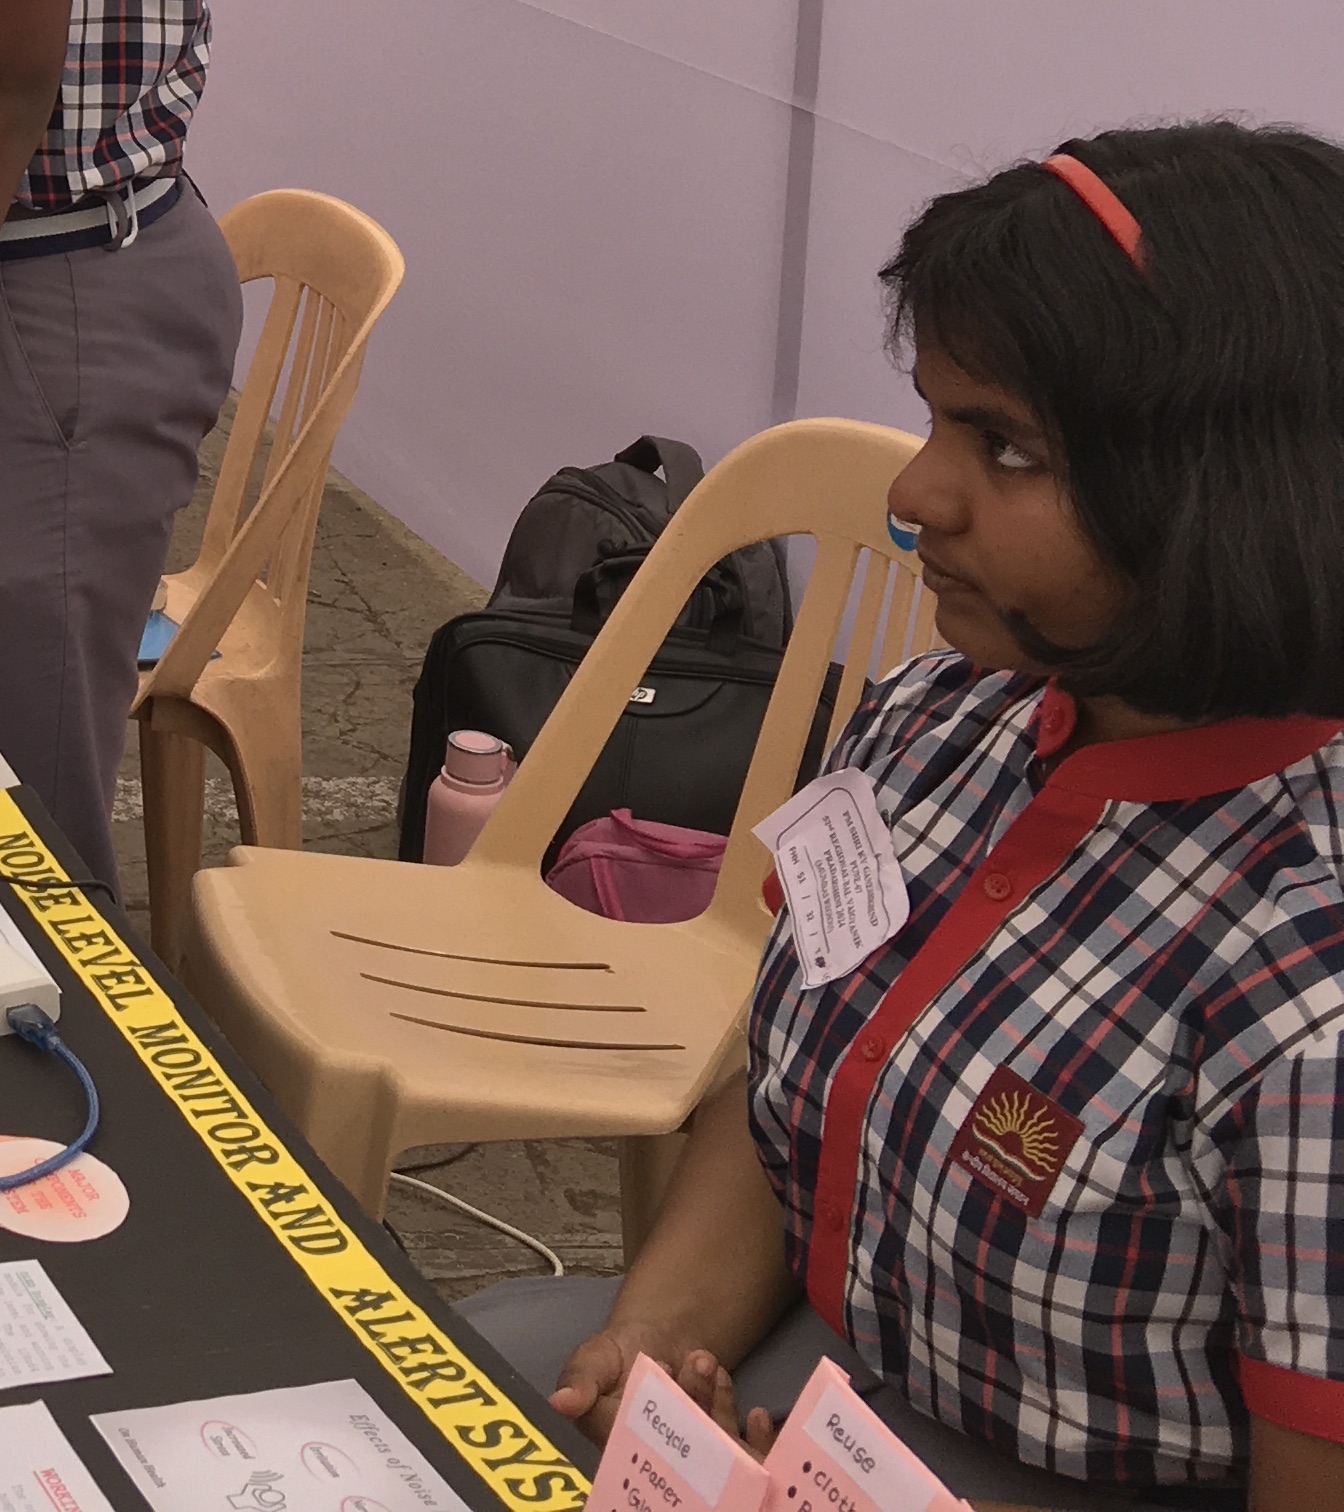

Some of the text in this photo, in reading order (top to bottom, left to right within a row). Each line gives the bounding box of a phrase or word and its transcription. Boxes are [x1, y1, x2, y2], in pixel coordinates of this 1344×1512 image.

[842, 809, 854, 827] PM
[846, 826, 863, 850] SHRI
[828, 832, 850, 880] REGIONAL
[33, 1157, 87, 1218] CPONENTS
[53, 910, 154, 1011] LEVEL
[124, 1022, 281, 1175] MONITOR
[245, 1178, 351, 1258] AND
[330, 1284, 497, 1418] ALERT
[67, 1169, 100, 1200] MAJOR
[1, 1188, 29, 1214] STEM
[30, 1191, 52, 1209] THE
[640, 1399, 692, 1460] Recycle
[825, 1413, 877, 1476] Reuse
[308, 1445, 339, 1478] Irritation
[349, 1413, 390, 1454] Effects
[385, 1458, 413, 1470] of
[399, 1473, 438, 1508] Noise
[638, 1459, 683, 1508] Paper
